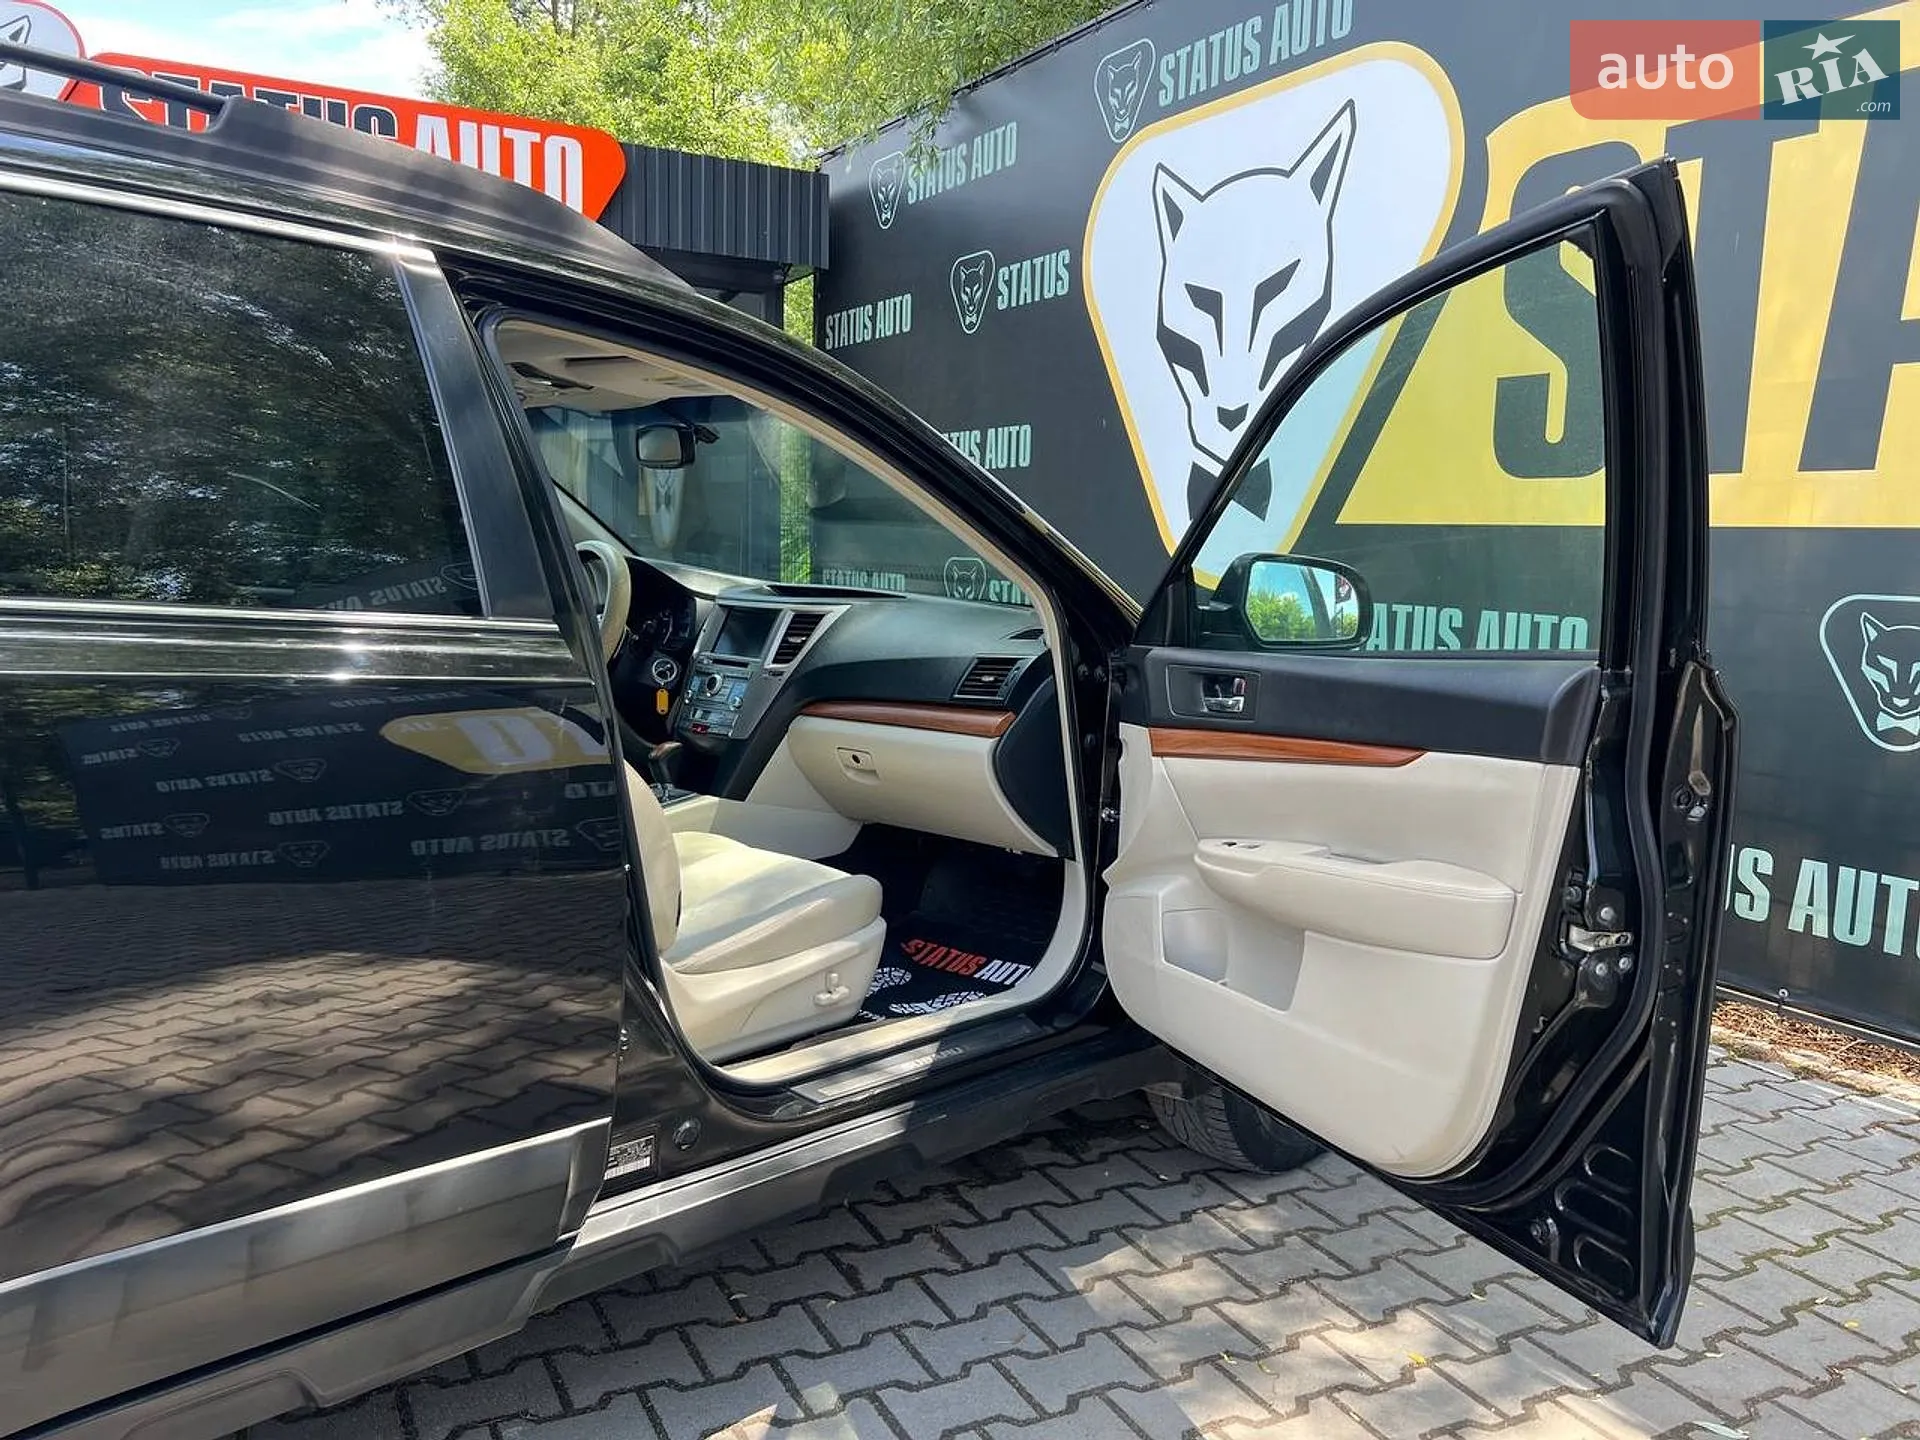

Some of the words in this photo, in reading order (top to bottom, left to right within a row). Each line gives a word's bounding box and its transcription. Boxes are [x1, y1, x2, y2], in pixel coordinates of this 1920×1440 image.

[1159, 15, 1263, 107] STATUS
[1269, 0, 1354, 66] AUTO
[970, 121, 1017, 181] AUTO
[997, 249, 1070, 311] STATUS
[825, 304, 873, 350] STATUS
[875, 293, 912, 339] AUTO
[984, 424, 1031, 469] AUTO
[1364, 602, 1463, 650] ATUS
[1788, 858, 1920, 960] AUT
[901, 939, 987, 976] STATUS
[973, 959, 1033, 986] AUT
